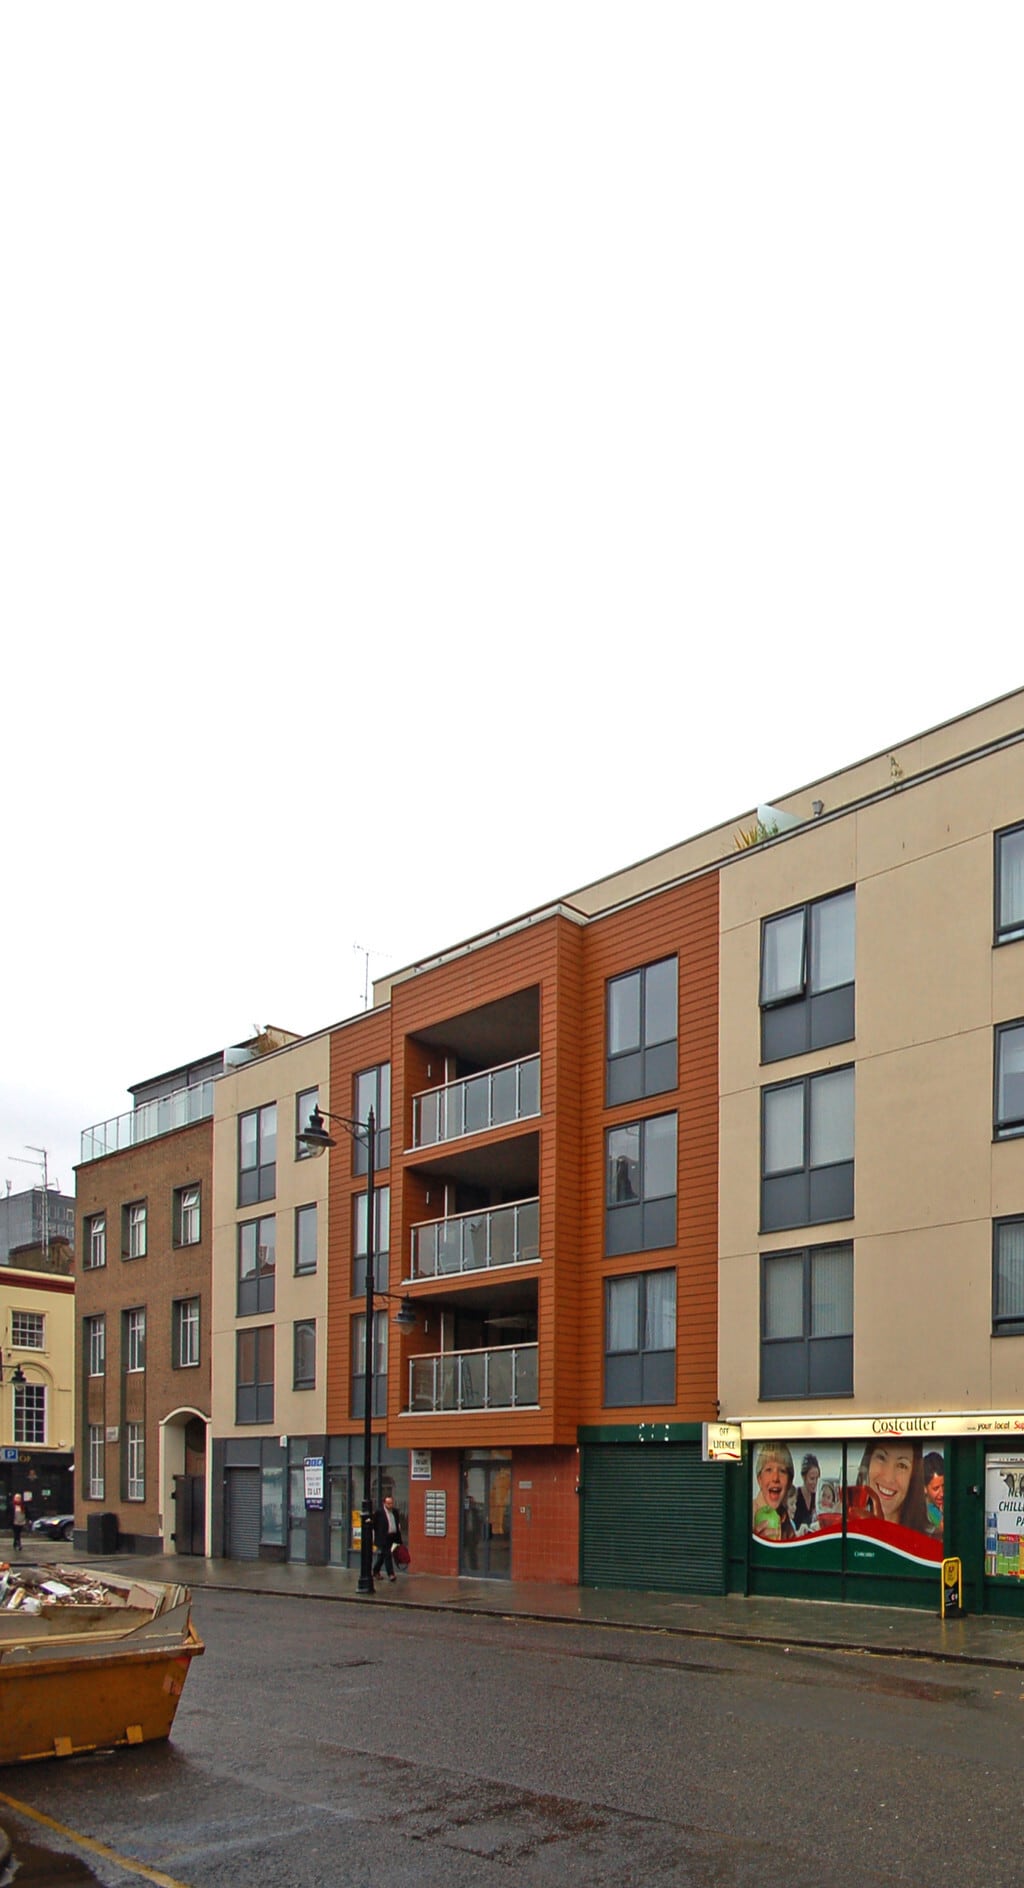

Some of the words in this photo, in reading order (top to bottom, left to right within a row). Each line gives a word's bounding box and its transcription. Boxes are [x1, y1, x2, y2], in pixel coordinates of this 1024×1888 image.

[872, 1418, 936, 1433] Costcutter
[994, 1421, 1010, 1430] local
[719, 1427, 729, 1437] OFF
[713, 1440, 735, 1449] LICENCE
